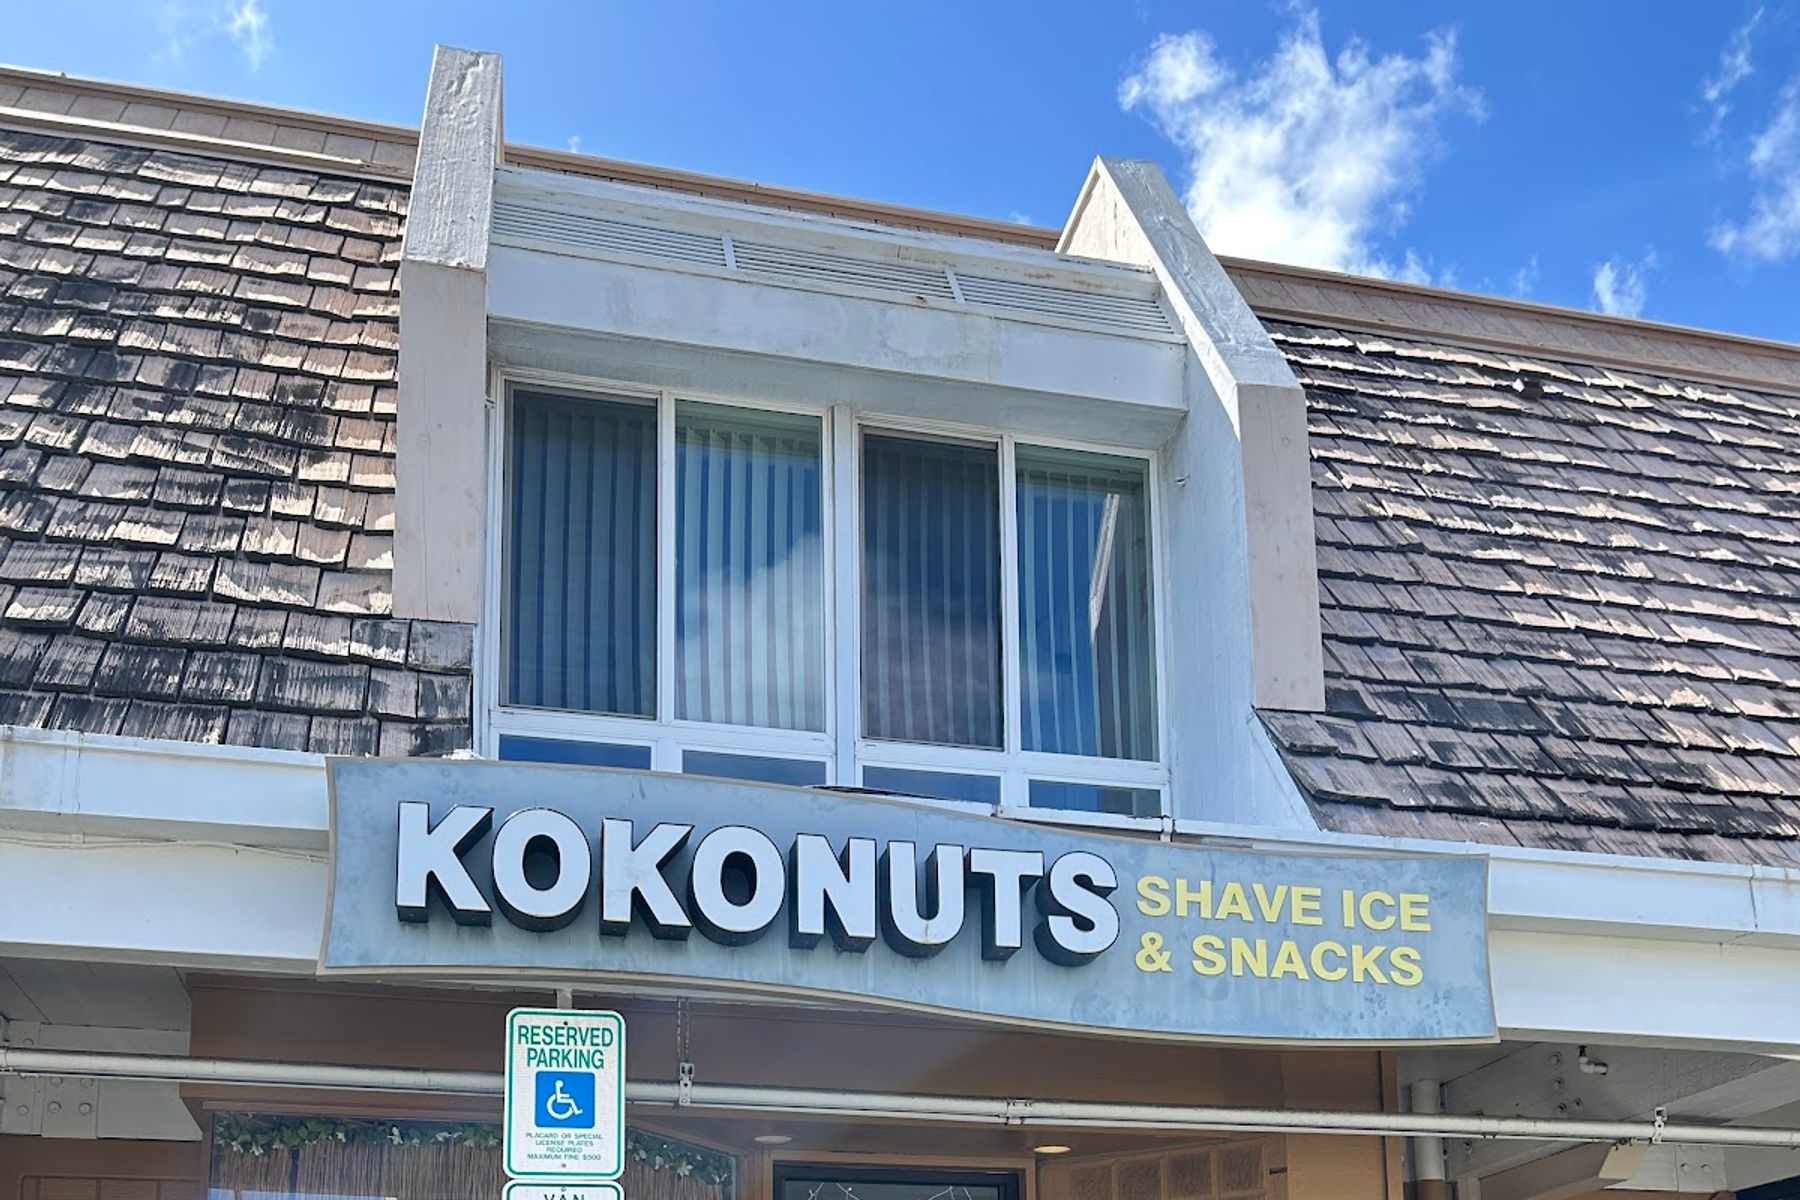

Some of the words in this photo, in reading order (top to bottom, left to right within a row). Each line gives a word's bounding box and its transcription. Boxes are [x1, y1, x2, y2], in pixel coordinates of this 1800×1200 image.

[395, 800, 1120, 957] KOKONUTS
[1136, 876, 1323, 926] SHAVE
[1342, 889, 1431, 932] ICE
[1135, 932, 1173, 973] &
[1192, 935, 1423, 986] SNACKS
[517, 1024, 614, 1047] RESERVED
[527, 1047, 605, 1069] PARKING
[527, 1153, 562, 1161] MAXIMUM
